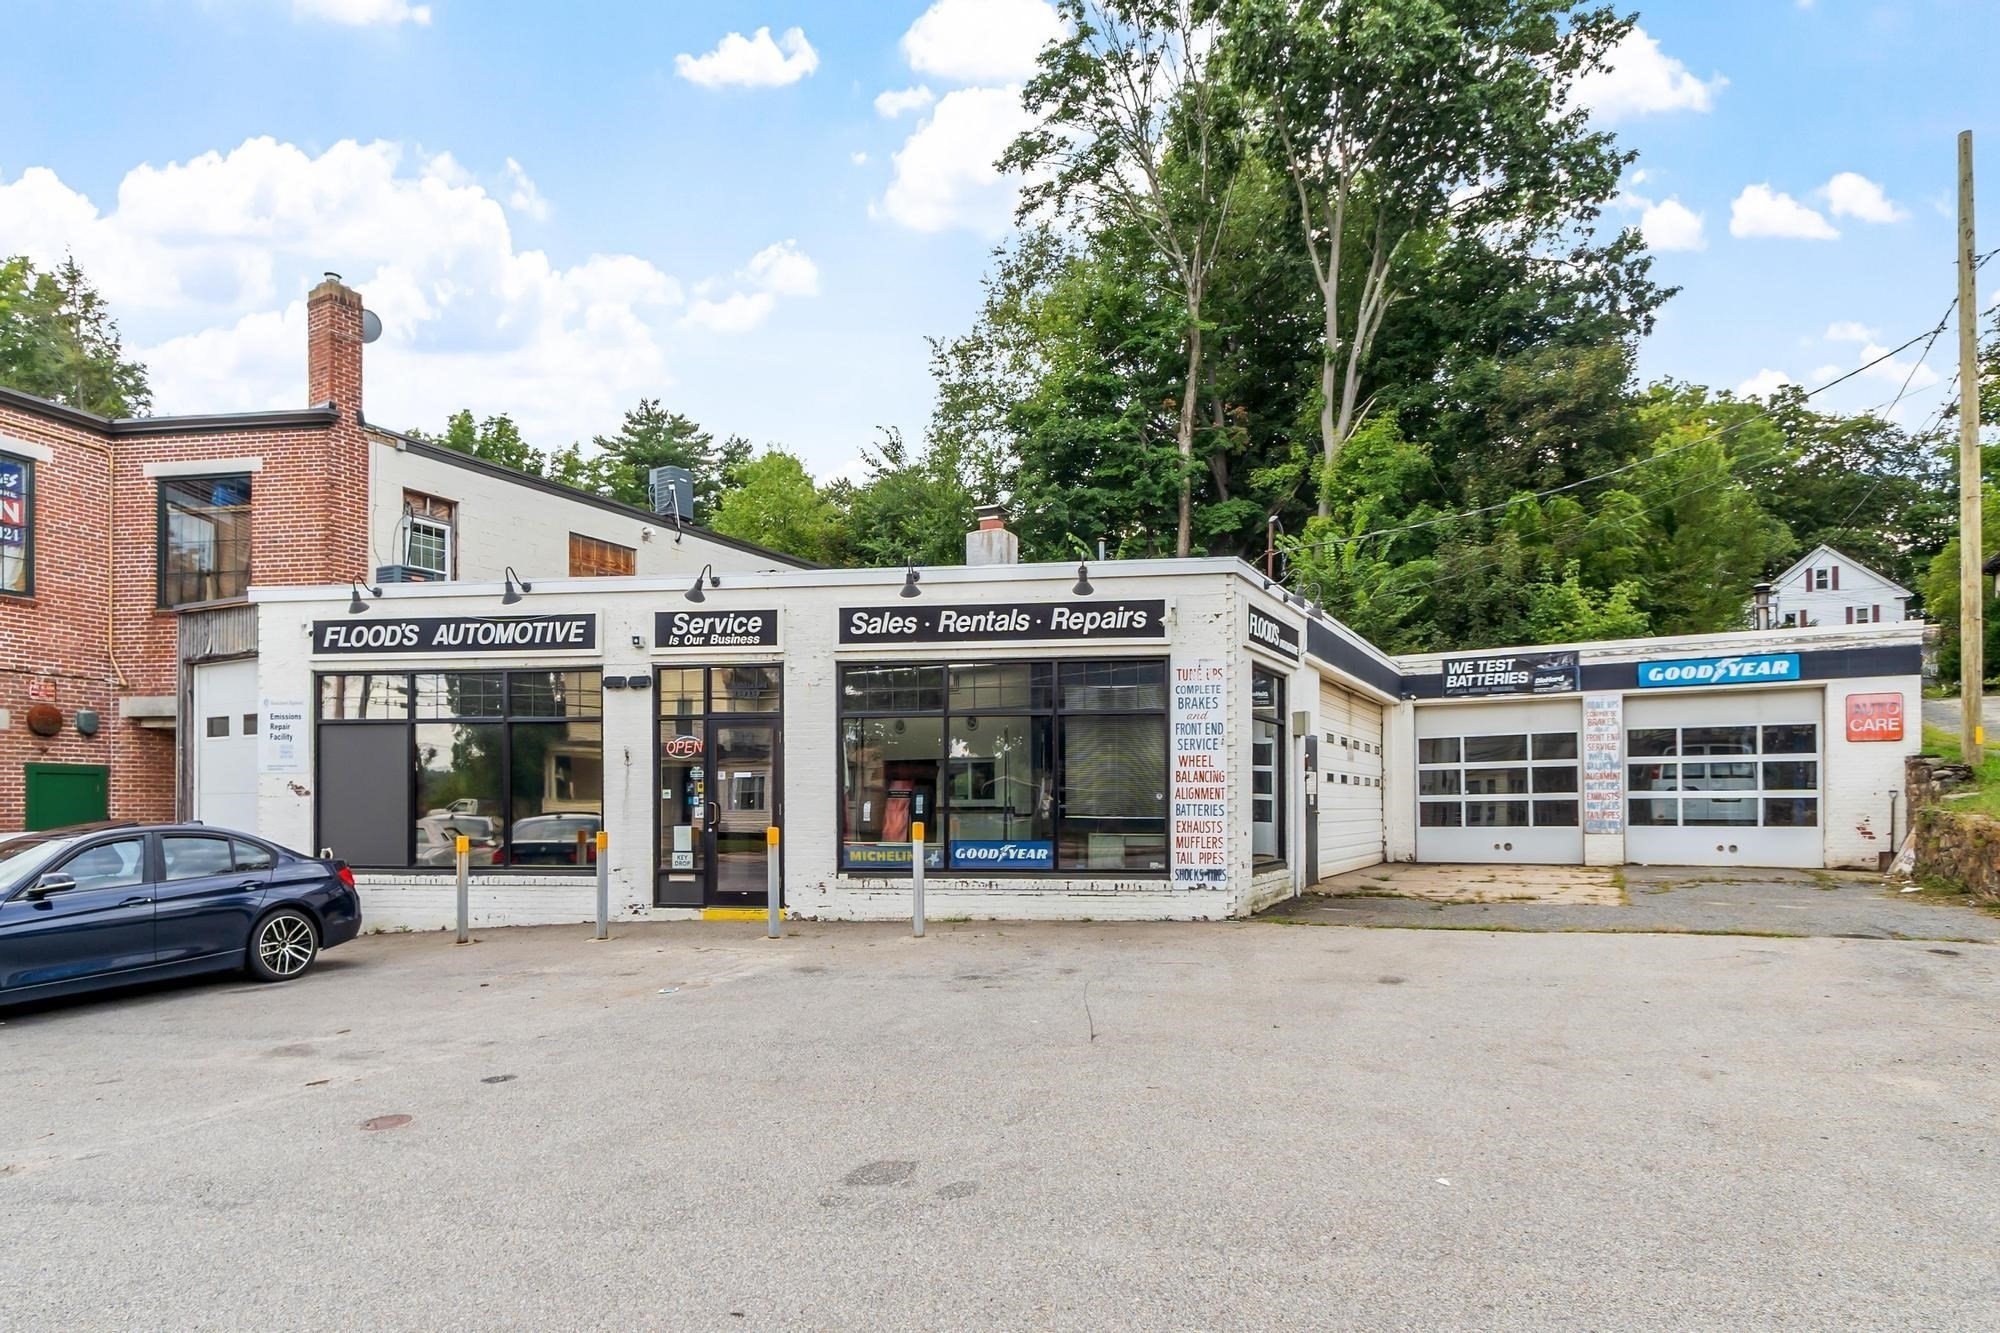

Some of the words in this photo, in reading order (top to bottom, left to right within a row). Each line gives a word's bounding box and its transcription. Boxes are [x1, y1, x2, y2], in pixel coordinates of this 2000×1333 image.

[671, 613, 763, 635] Service
[850, 611, 918, 635] Sales
[938, 609, 1030, 633] Rentals
[1050, 606, 1148, 635] Repairs
[323, 623, 420, 648] FLOOD'S
[431, 620, 586, 646] AUTOMOTIVE
[668, 634, 680, 645] Is
[684, 634, 705, 645] Our
[710, 633, 760, 645] Business
[1447, 661, 1474, 675] WE
[1477, 658, 1516, 673] TEST
[1446, 671, 1529, 688] BATTERIES
[1175, 685, 1221, 694] COMPLETE
[1177, 697, 1219, 710] BRAKES
[269, 712, 302, 720] Emissions
[1186, 711, 1209, 720] and
[269, 723, 291, 731] Repair
[1175, 722, 1202, 736] FRONT
[1205, 722, 1224, 736] END
[1850, 717, 1901, 732] CARE
[269, 733, 293, 742] Facility
[1177, 737, 1219, 751] SERVICE
[666, 740, 703, 755] OPEN
[1178, 754, 1214, 768] WHEEL
[1175, 770, 1225, 783] BALANCING
[1174, 786, 1225, 800] ALIGNMENT
[1175, 803, 1225, 816] BATTERIES
[1176, 820, 1223, 834] EXHAUSTS
[1175, 836, 1224, 849] MUFFLERS
[1175, 851, 1195, 865] TAIL
[1199, 851, 1225, 865] PIPES
